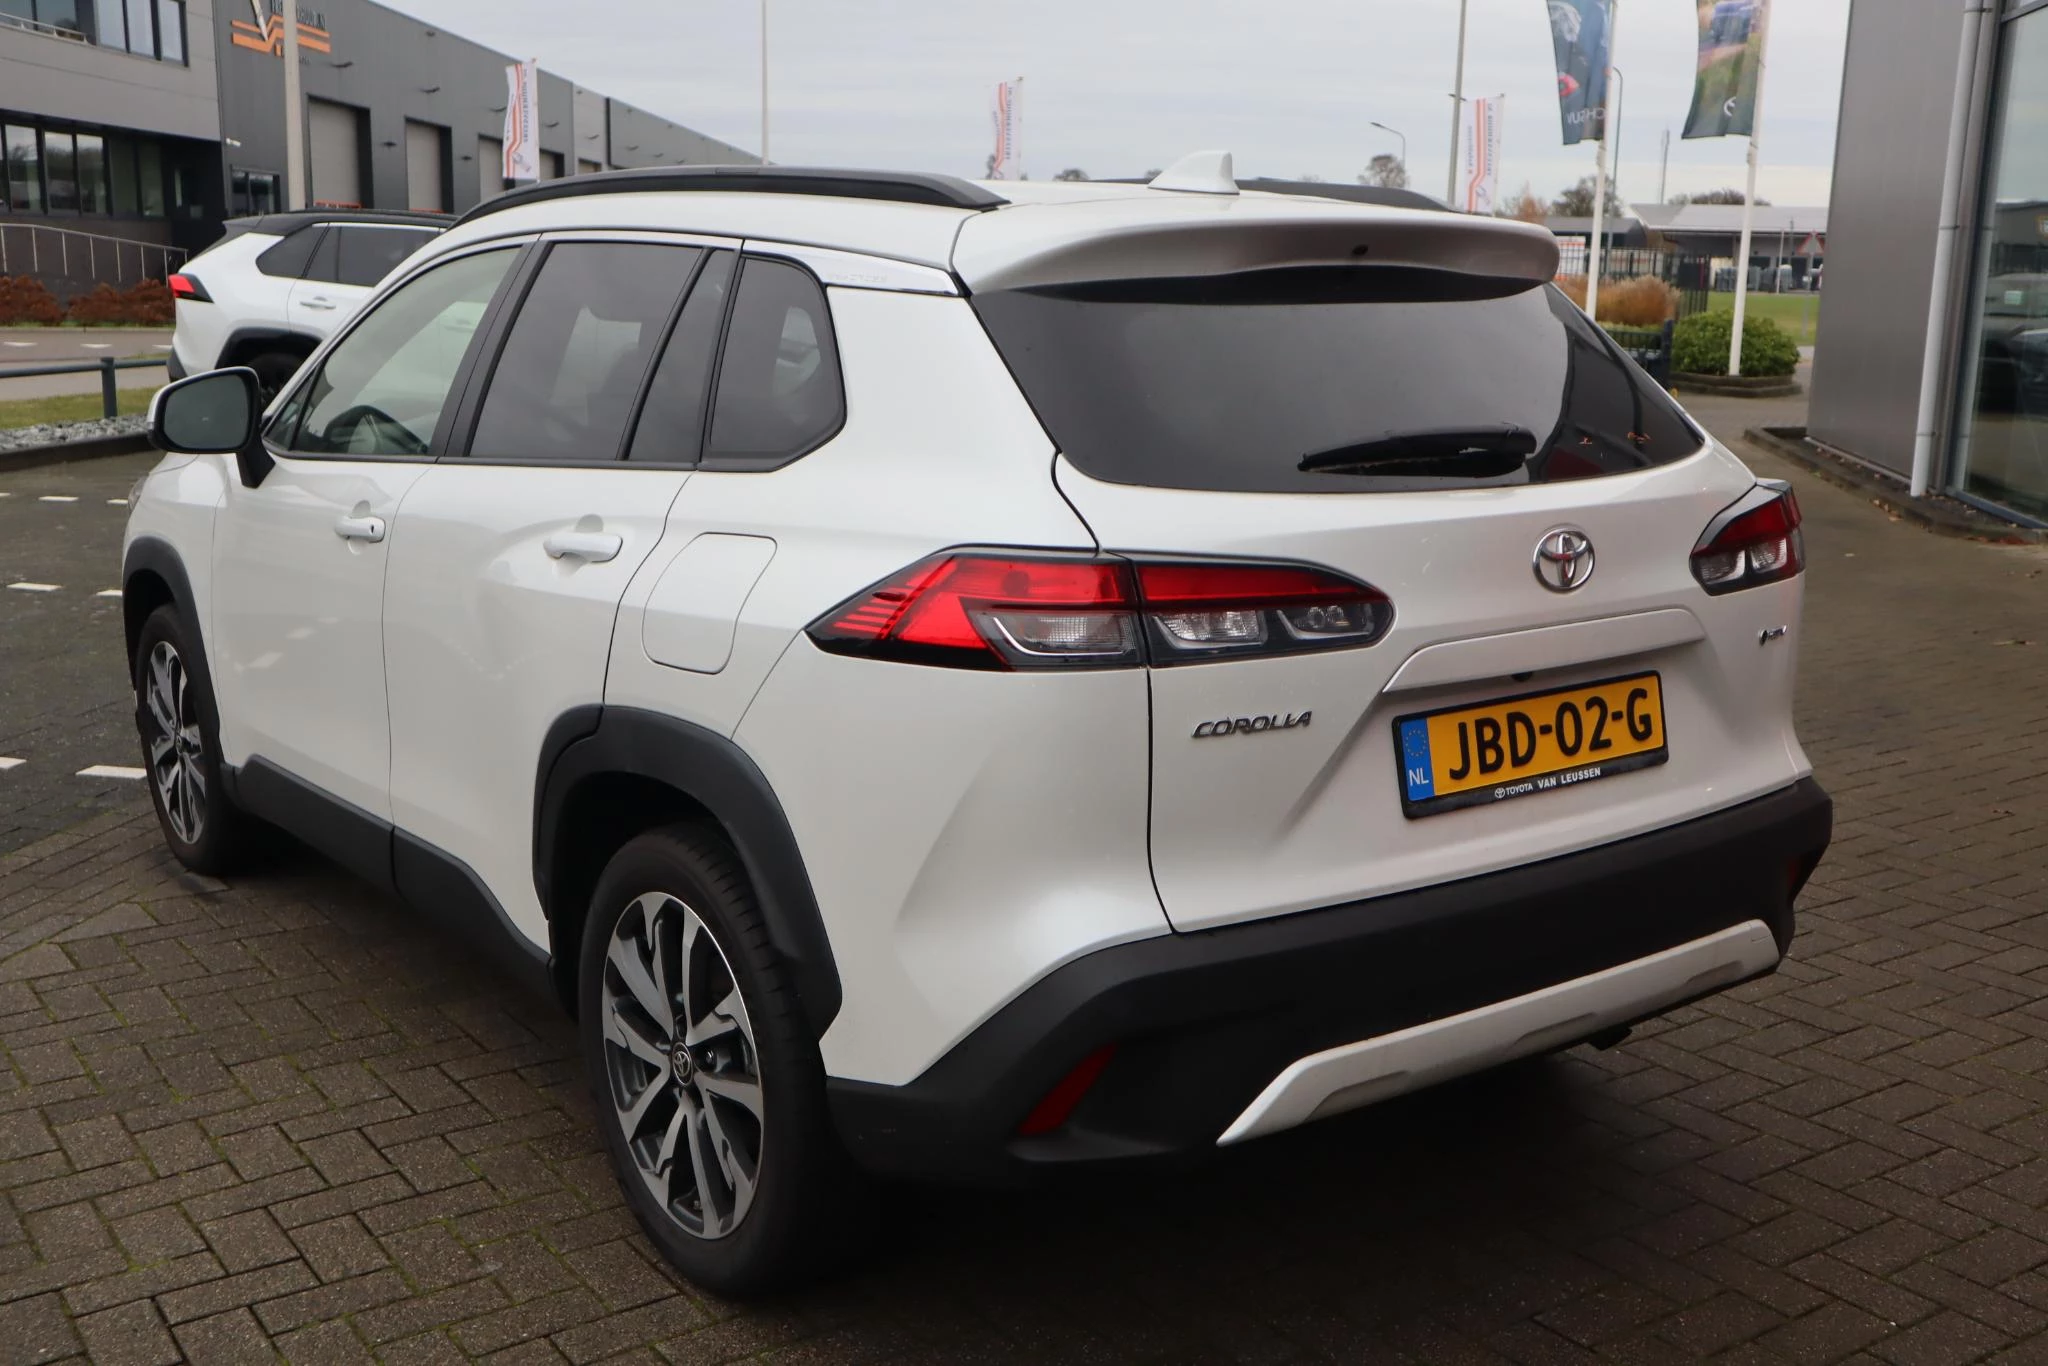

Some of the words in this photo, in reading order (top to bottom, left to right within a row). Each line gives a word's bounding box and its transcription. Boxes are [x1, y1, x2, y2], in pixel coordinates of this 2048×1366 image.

[1191, 710, 1312, 738] COROLLA
[1449, 688, 1653, 780] JBD-02-G
[1409, 768, 1429, 786] NL
[1506, 783, 1533, 795] TOYOTA
[1538, 777, 1557, 789] VAN
[1561, 767, 1601, 784] LEUSSEN
